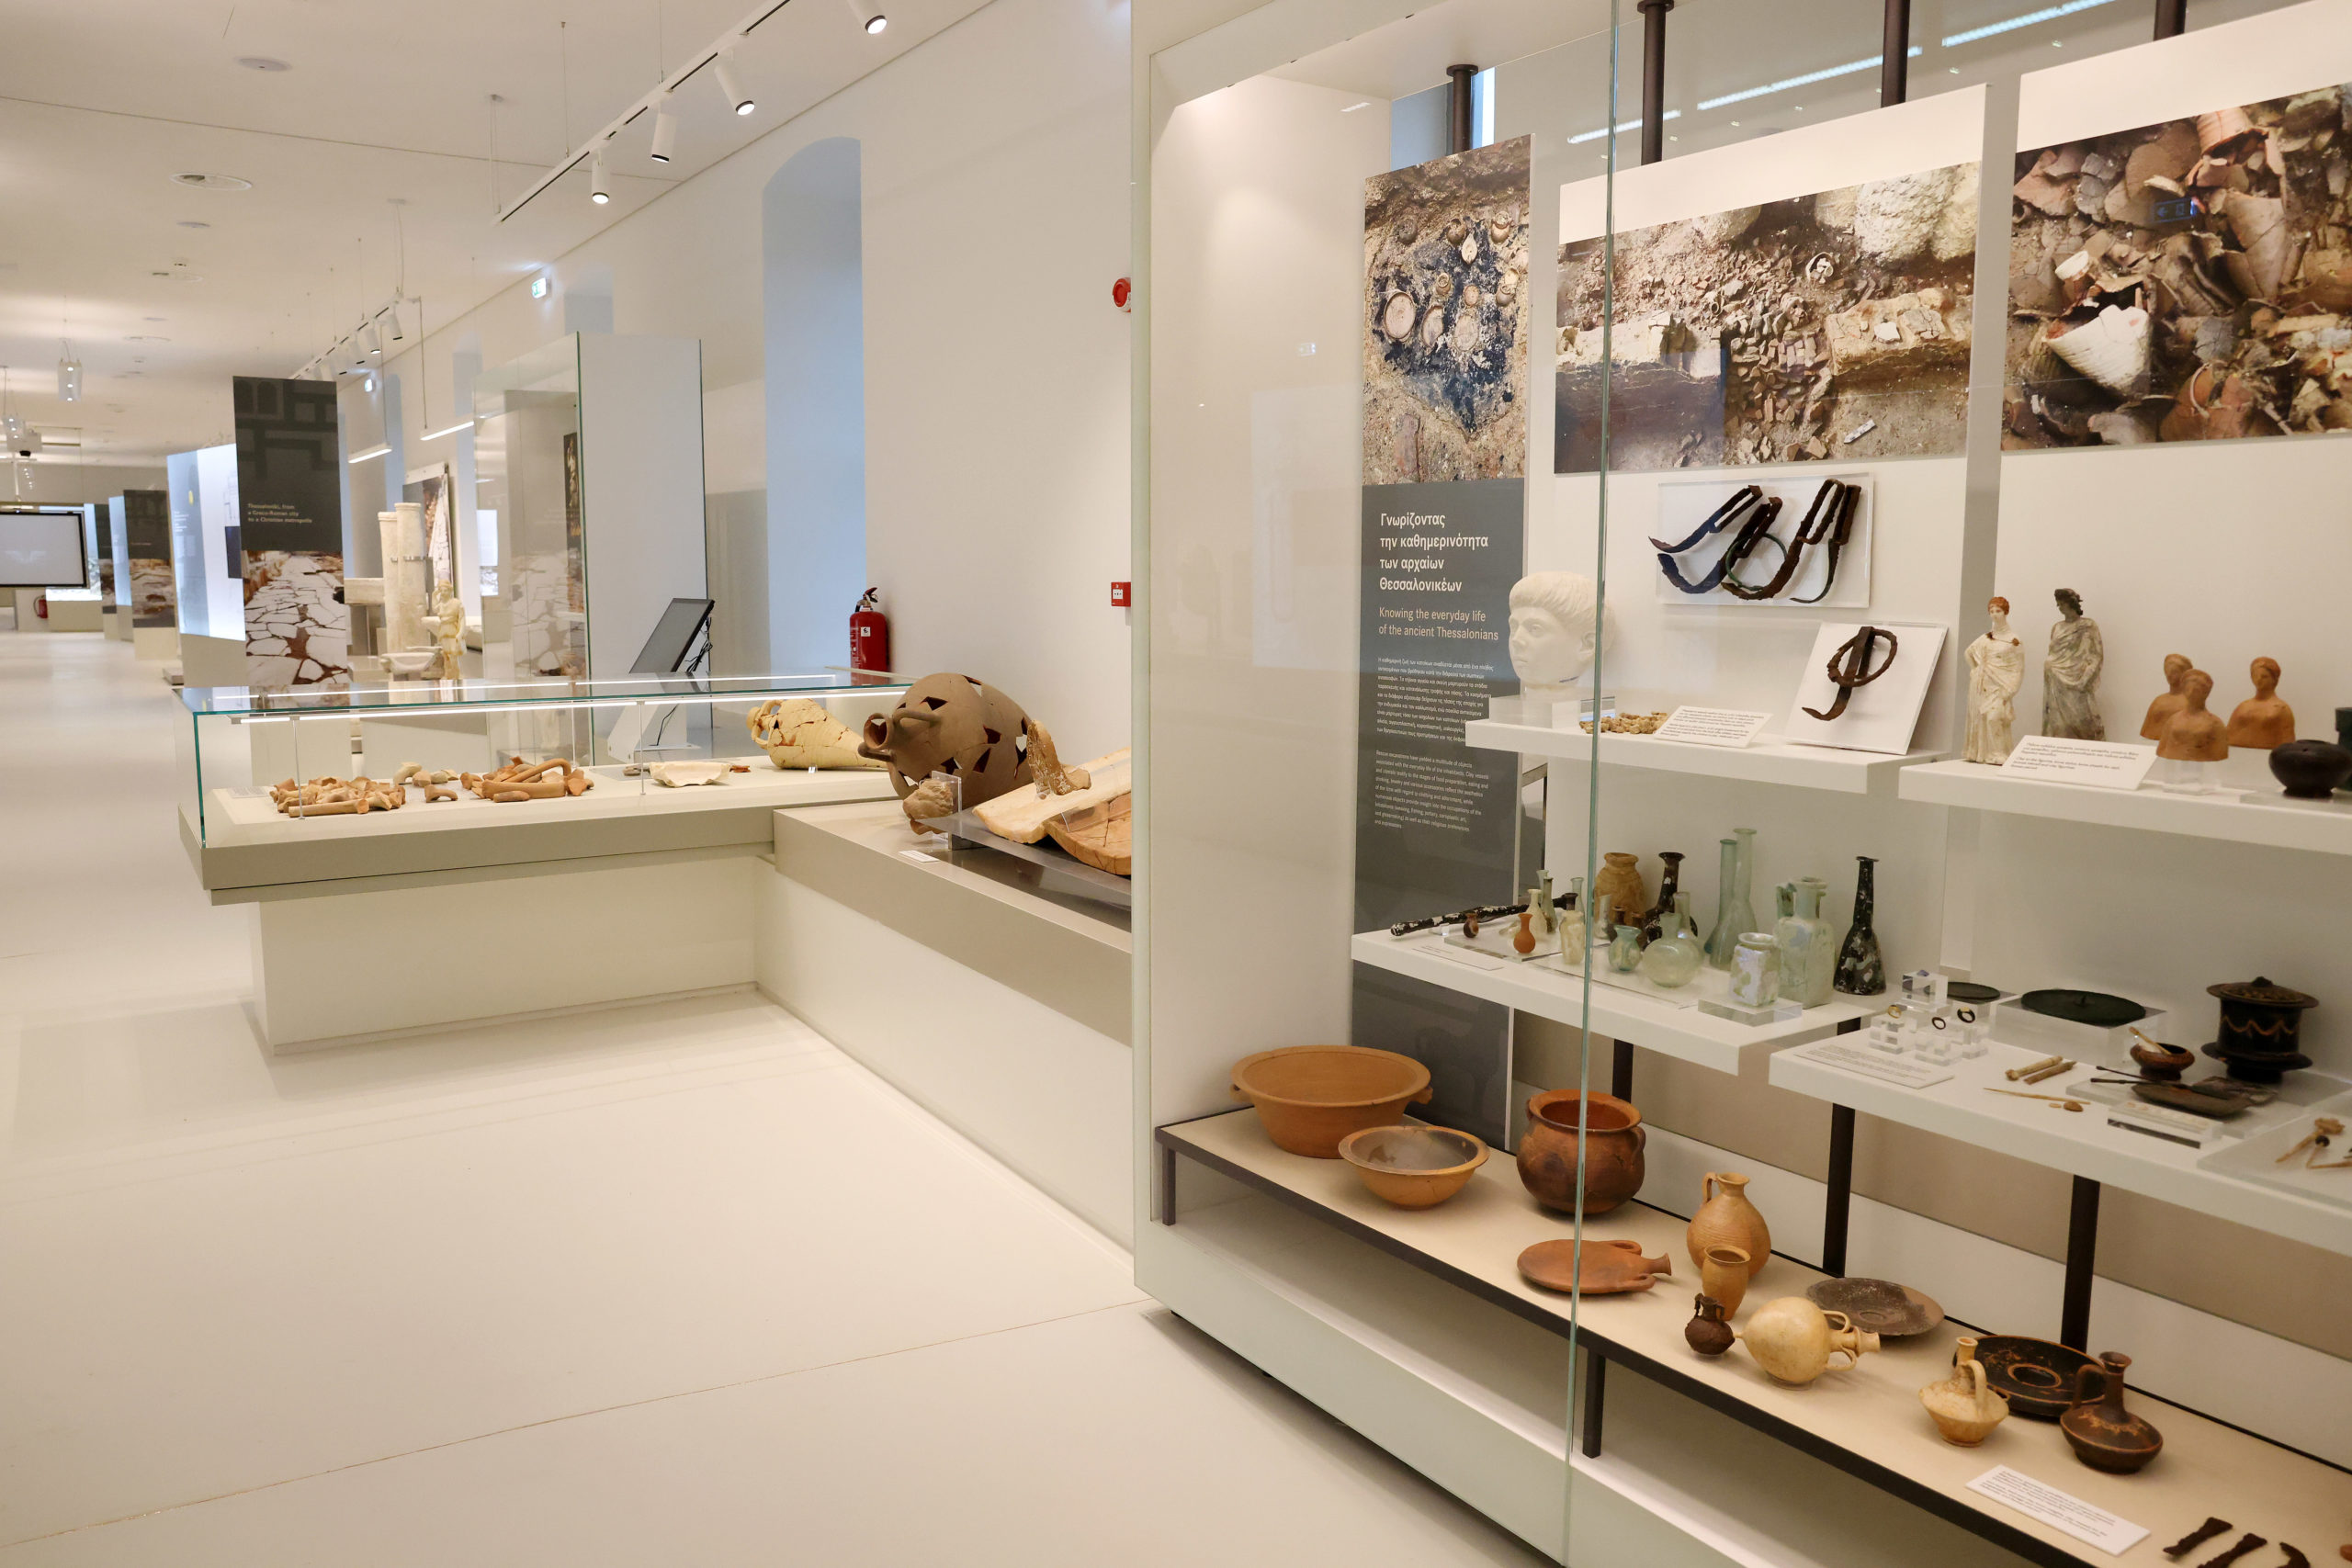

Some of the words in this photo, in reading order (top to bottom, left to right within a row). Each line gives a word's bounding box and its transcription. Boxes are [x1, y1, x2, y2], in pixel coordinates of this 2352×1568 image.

[1381, 513, 1445, 529] Γνωρίζοντας
[1380, 537, 1398, 550] την
[1400, 533, 1488, 550] καθημερινότητα
[1380, 558, 1398, 569] των
[1401, 555, 1444, 572] αρχαίων
[1379, 577, 1463, 592] Θεσσαλονικέων
[1379, 607, 1414, 621] Knowing
[1416, 608, 1429, 619] the
[1431, 610, 1469, 624] everyday
[1472, 611, 1486, 622] life
[1379, 625, 1387, 635] of
[1389, 625, 1402, 635] the
[1404, 626, 1434, 637] ancient
[1437, 626, 1498, 640] Thessalonians
